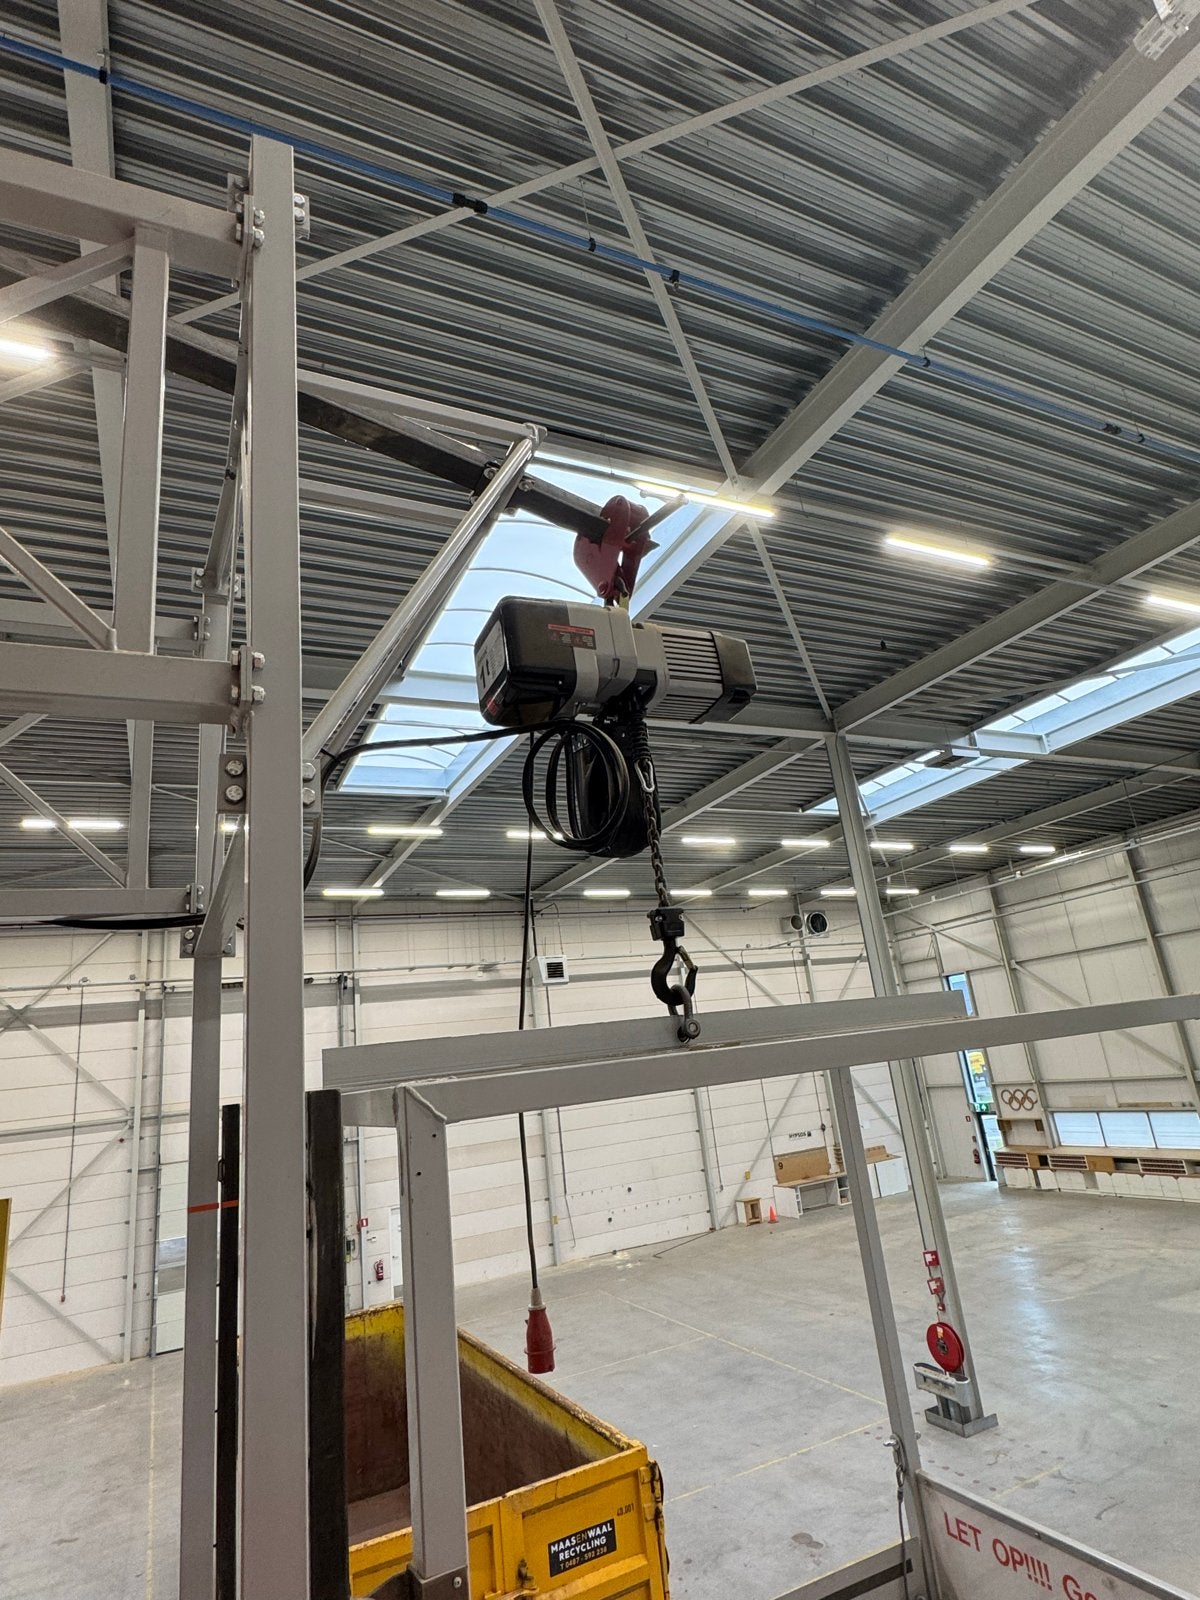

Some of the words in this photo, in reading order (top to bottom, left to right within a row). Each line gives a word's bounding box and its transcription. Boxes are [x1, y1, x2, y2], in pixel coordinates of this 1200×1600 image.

[777, 1161, 784, 1170] 9
[559, 1536, 607, 1561] RECYCLING
[584, 1550, 596, 1560] 592
[943, 1512, 982, 1552] LET
[992, 1538, 1053, 1592] OP!!!!
